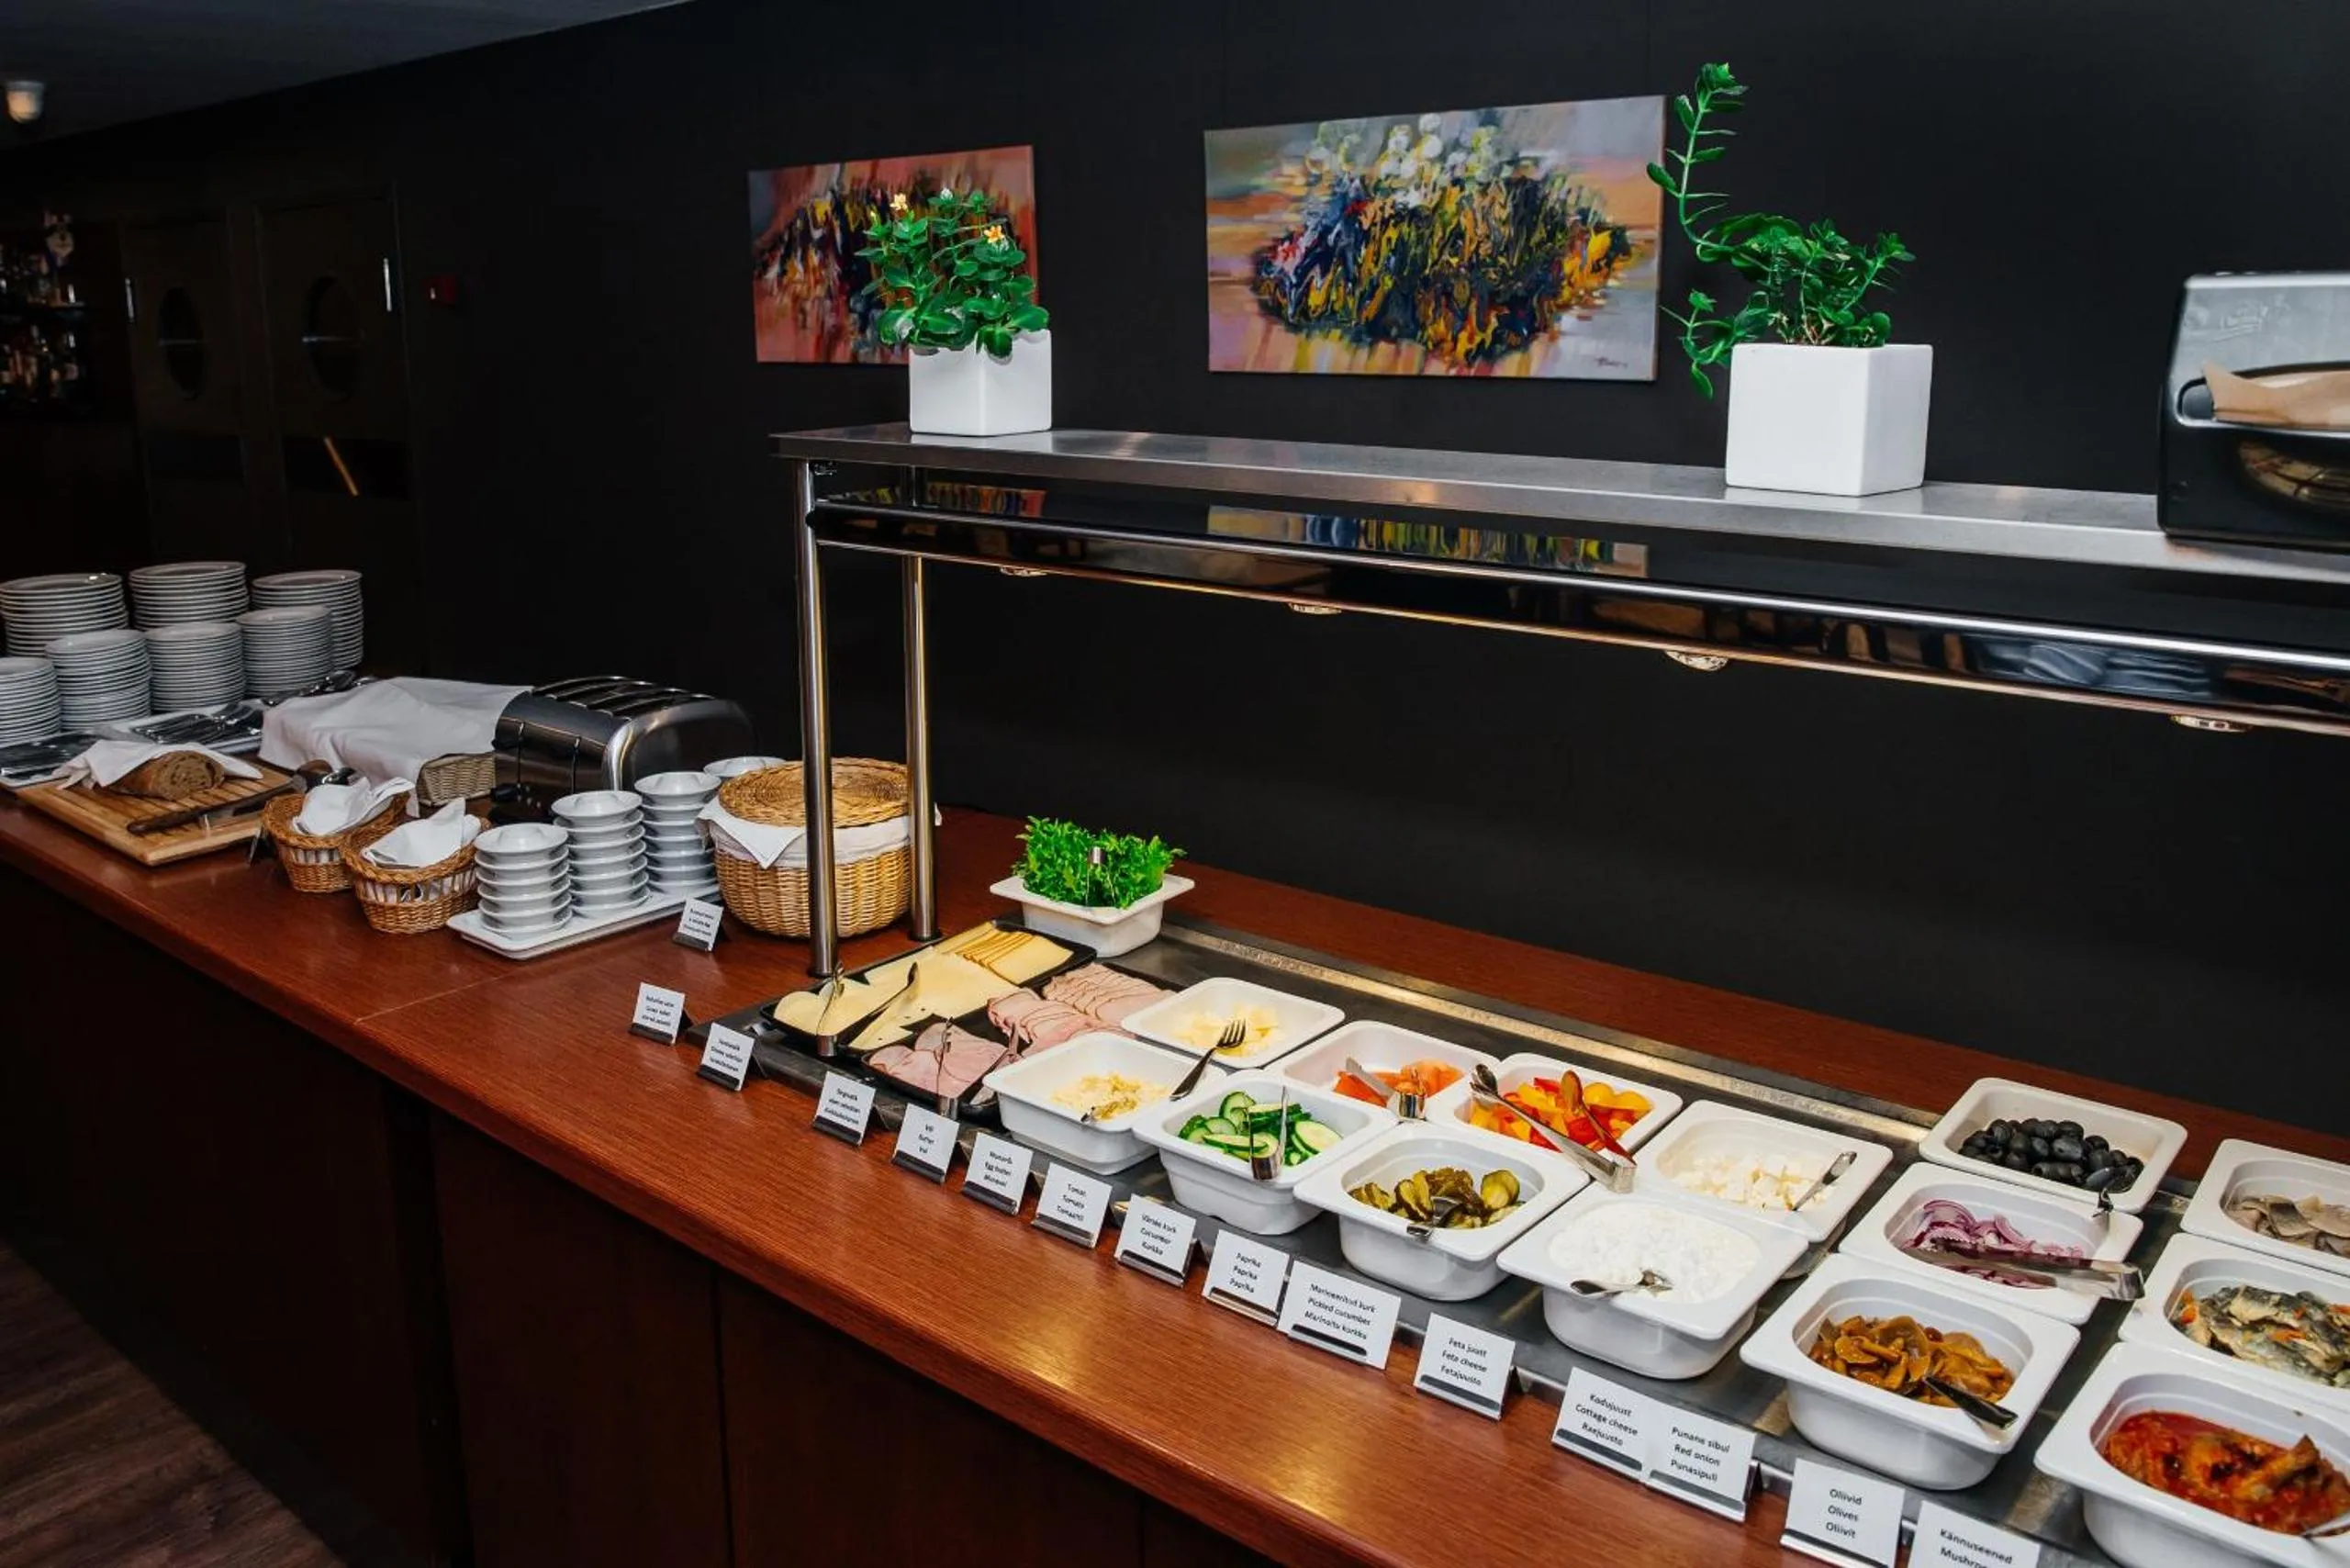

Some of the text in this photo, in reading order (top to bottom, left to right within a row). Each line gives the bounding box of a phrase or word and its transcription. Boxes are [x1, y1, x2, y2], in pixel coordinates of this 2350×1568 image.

[1308, 1297, 1371, 1327] Pickled cucumber
[1449, 1337, 1466, 1350] Feta
[1442, 1350, 1488, 1373] Feta cheese
[1440, 1365, 1482, 1386] Fetajuusto
[1590, 1394, 1632, 1417] Kodujuust
[1575, 1403, 1639, 1437] Cottage cheese
[1582, 1422, 1624, 1446] Raejuusto
[1671, 1426, 1731, 1453] Punane sibul
[1674, 1443, 1721, 1467] Red onion
[1671, 1459, 1718, 1483] Punasipuli
[1829, 1488, 1863, 1506] Oliivid
[1828, 1505, 1859, 1522] Olives
[1825, 1521, 1856, 1540] Oliivit
[1940, 1529, 2013, 1564] Kännuseened
